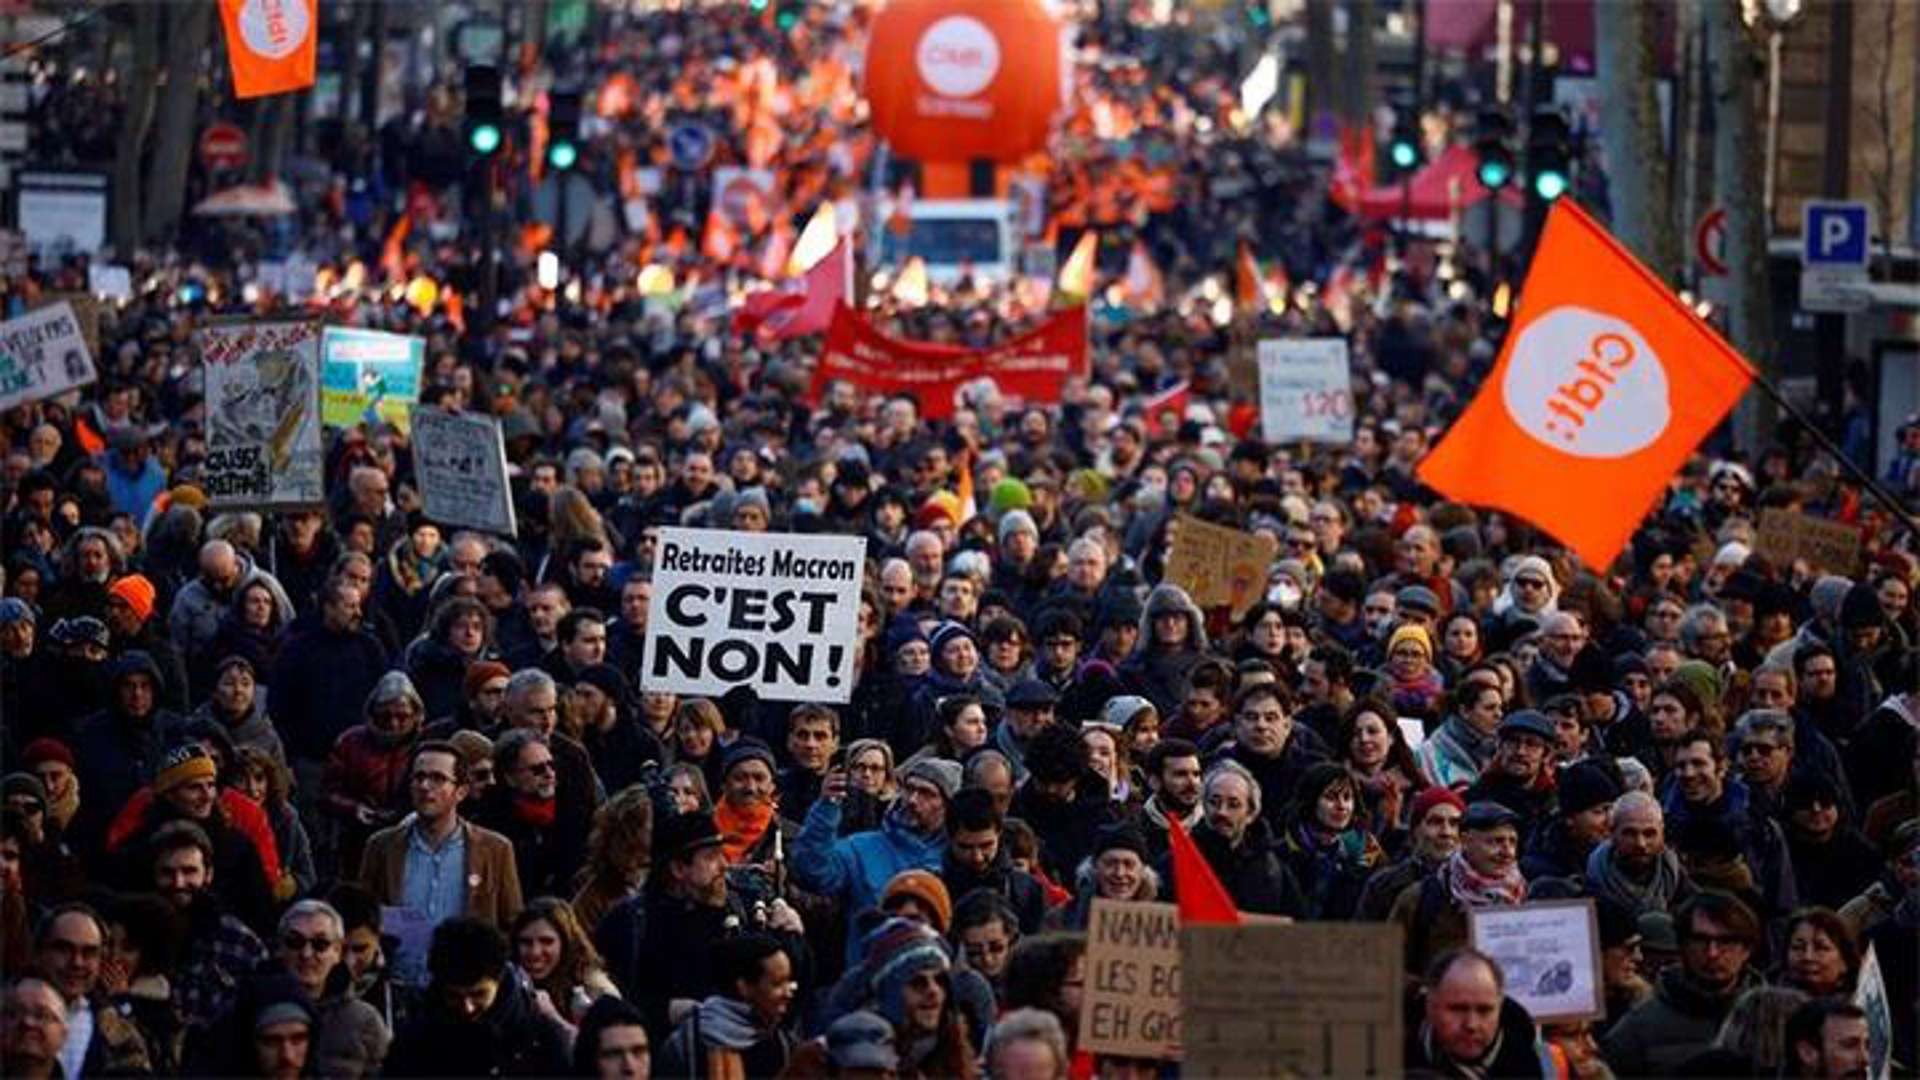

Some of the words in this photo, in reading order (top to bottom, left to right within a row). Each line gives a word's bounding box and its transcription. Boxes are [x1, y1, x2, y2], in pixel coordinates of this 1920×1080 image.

[1821, 216, 1851, 255] P
[661, 543, 765, 577] Retraites
[771, 550, 855, 580] Macron
[665, 583, 838, 634] C'EST
[1095, 960, 1138, 995] LES
[1091, 1003, 1131, 1039] EH
